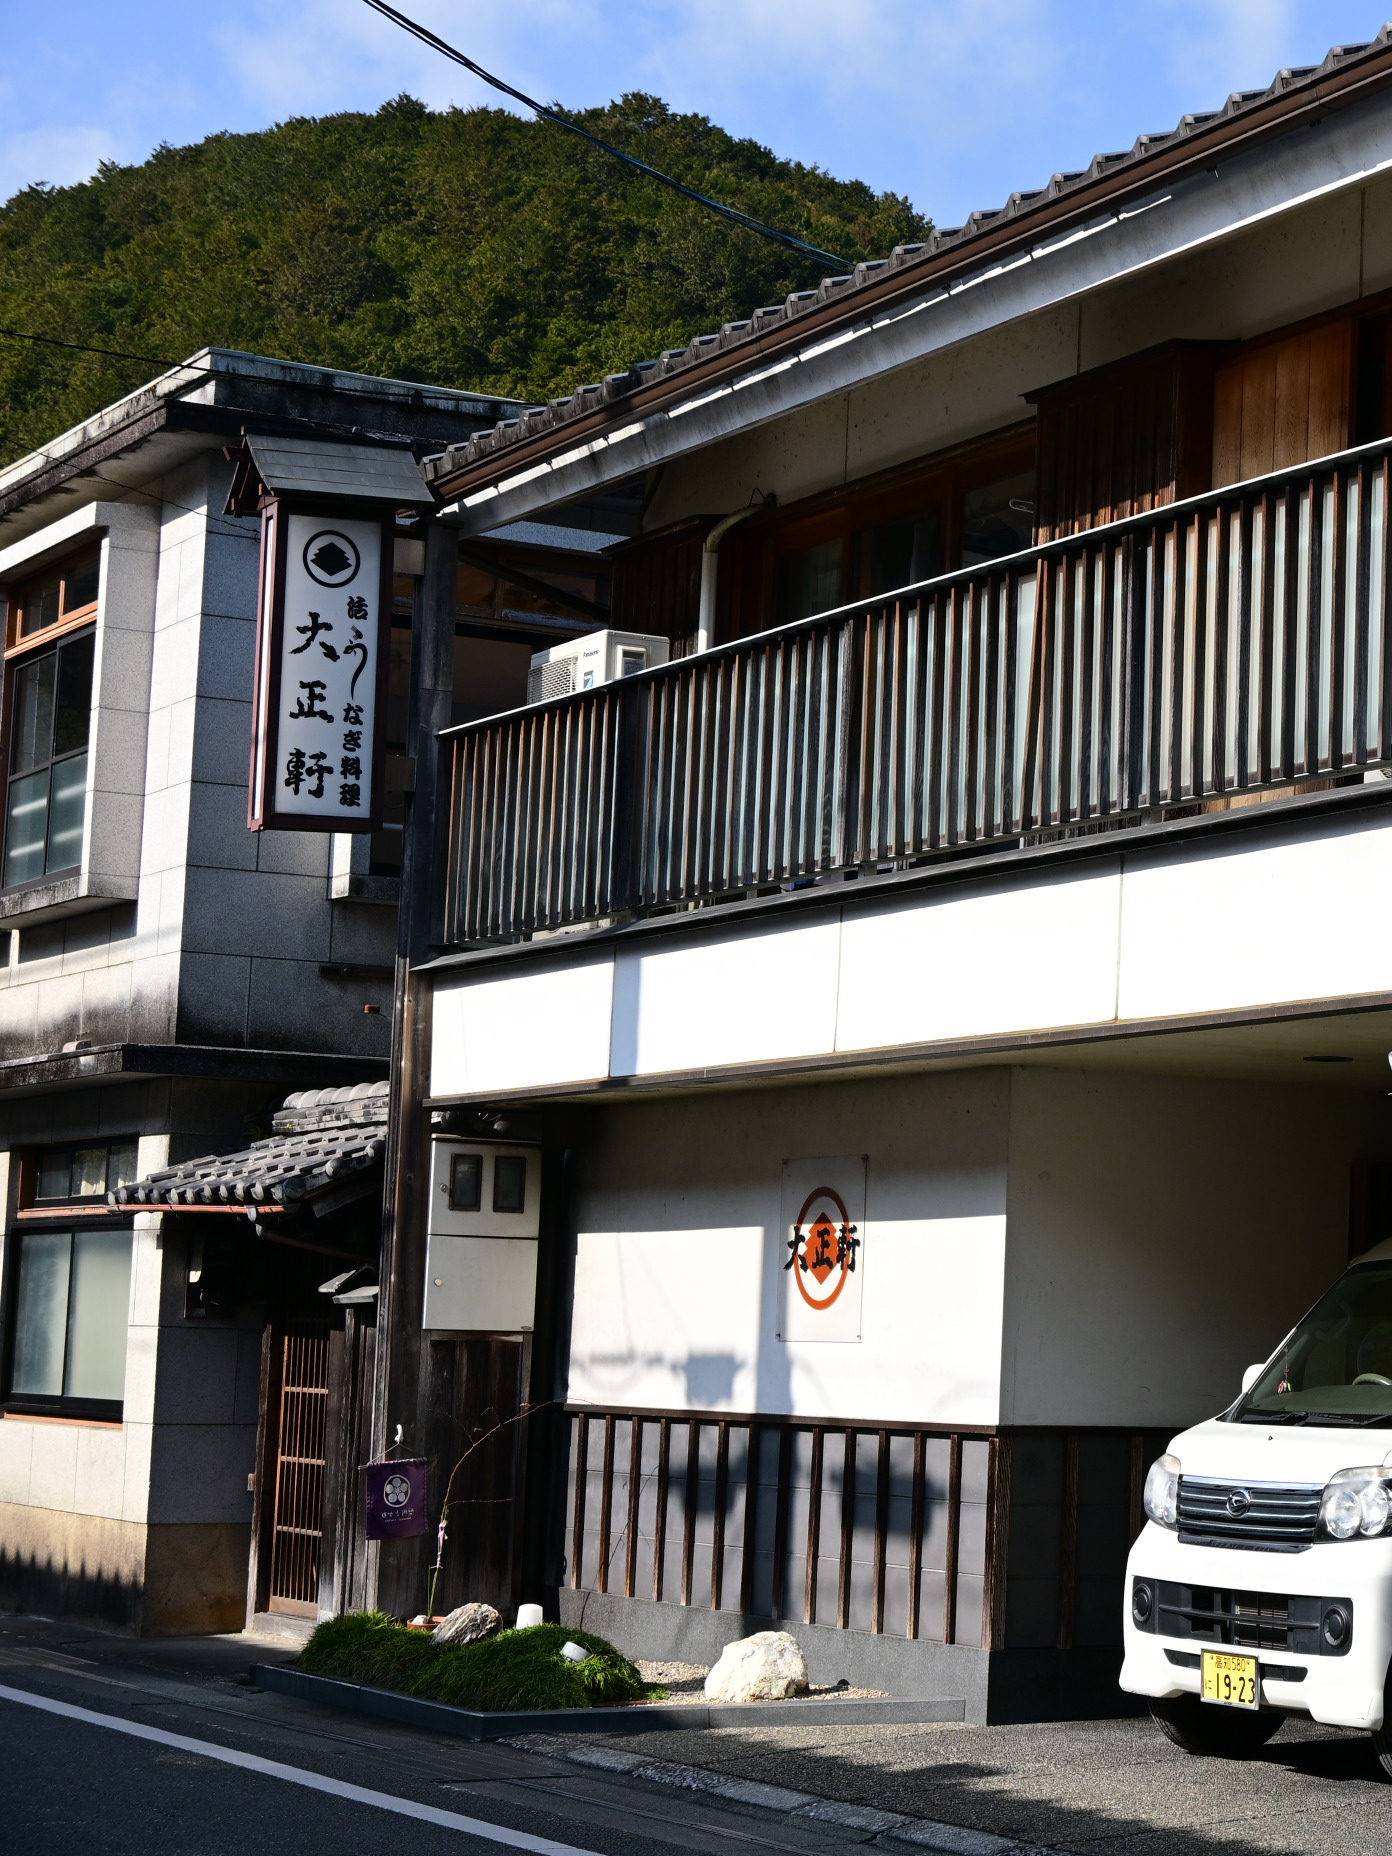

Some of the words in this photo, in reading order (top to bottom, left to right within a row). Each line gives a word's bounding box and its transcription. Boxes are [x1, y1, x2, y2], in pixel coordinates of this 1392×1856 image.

[583, 649, 599, 658] Panasonic
[284, 611, 341, 799] 大正軒
[782, 1223, 861, 1273] 大正軒
